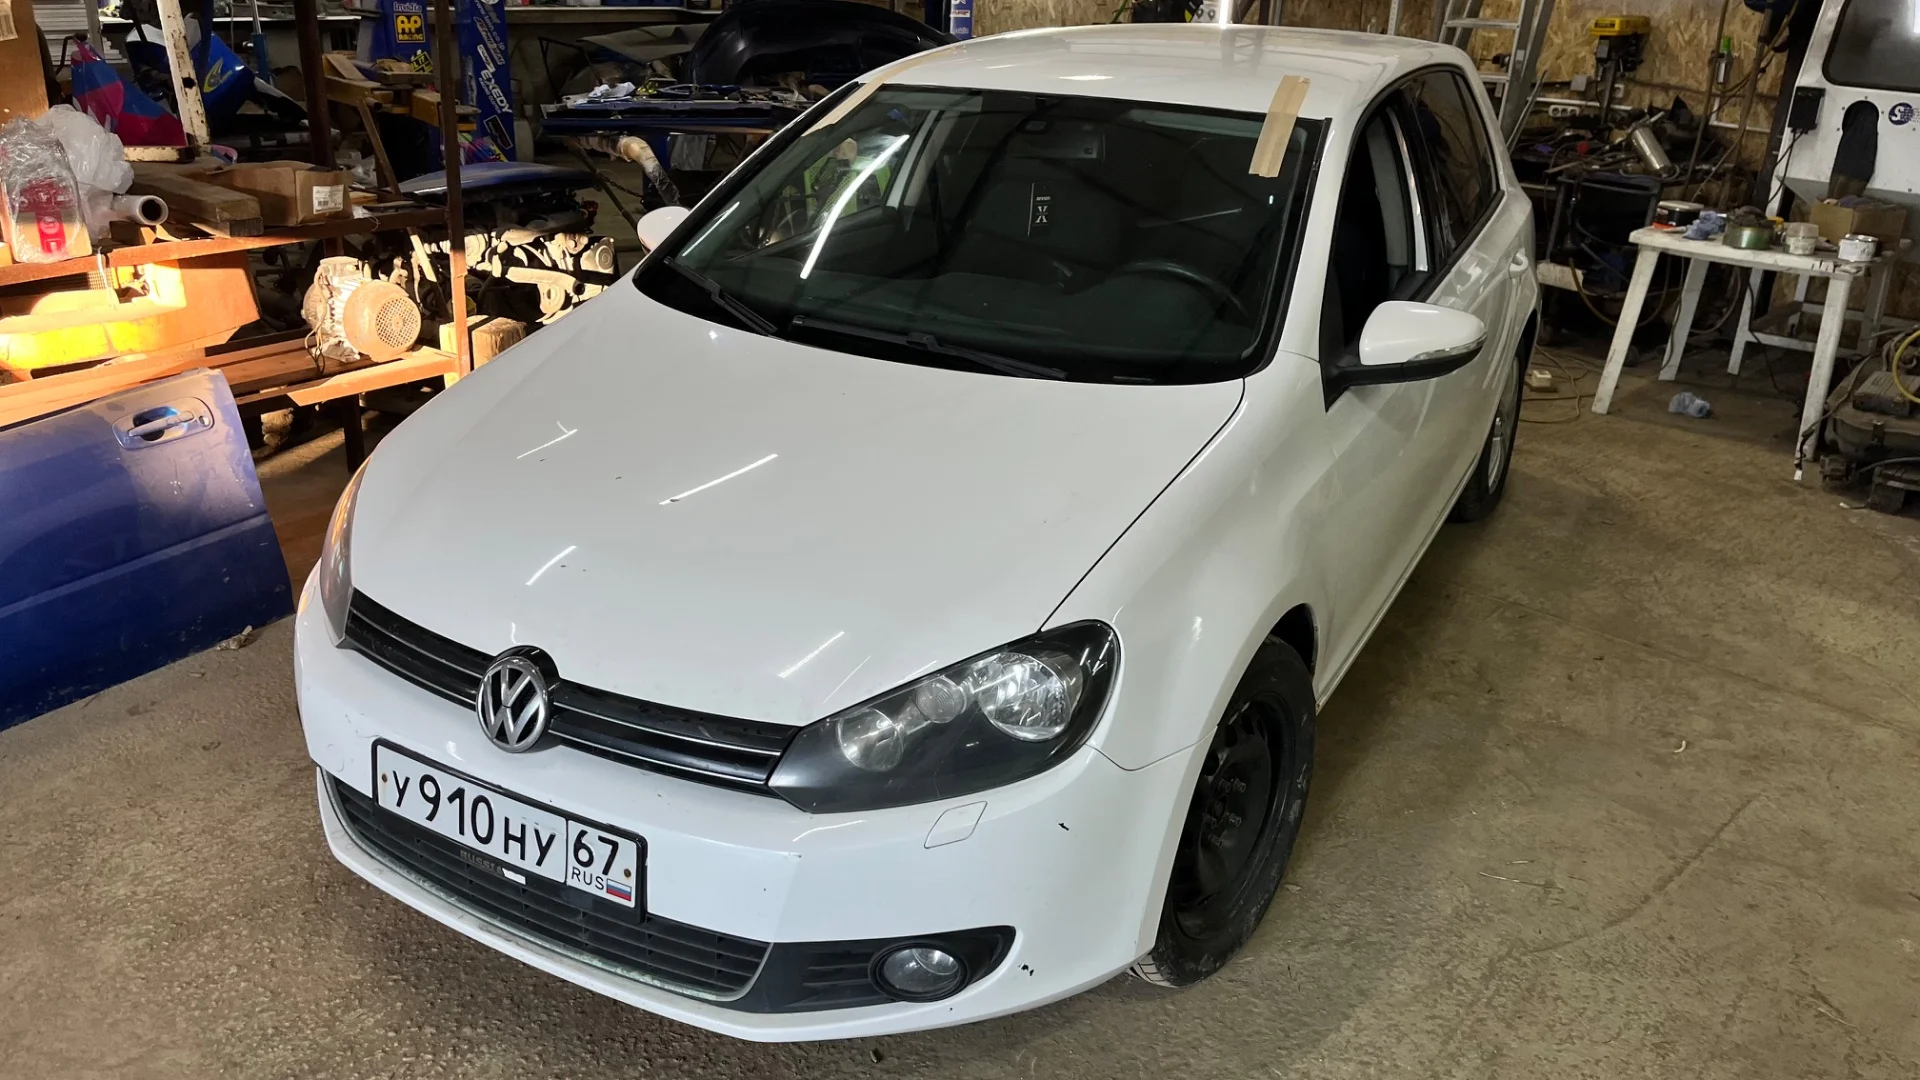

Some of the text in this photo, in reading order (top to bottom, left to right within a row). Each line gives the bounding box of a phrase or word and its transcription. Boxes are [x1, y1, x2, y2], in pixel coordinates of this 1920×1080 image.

[396, 15, 422, 34] AP
[398, 33, 424, 41] RACING
[480, 69, 512, 112] EXEDY
[572, 829, 620, 876] 67
[571, 866, 605, 891] RUS
